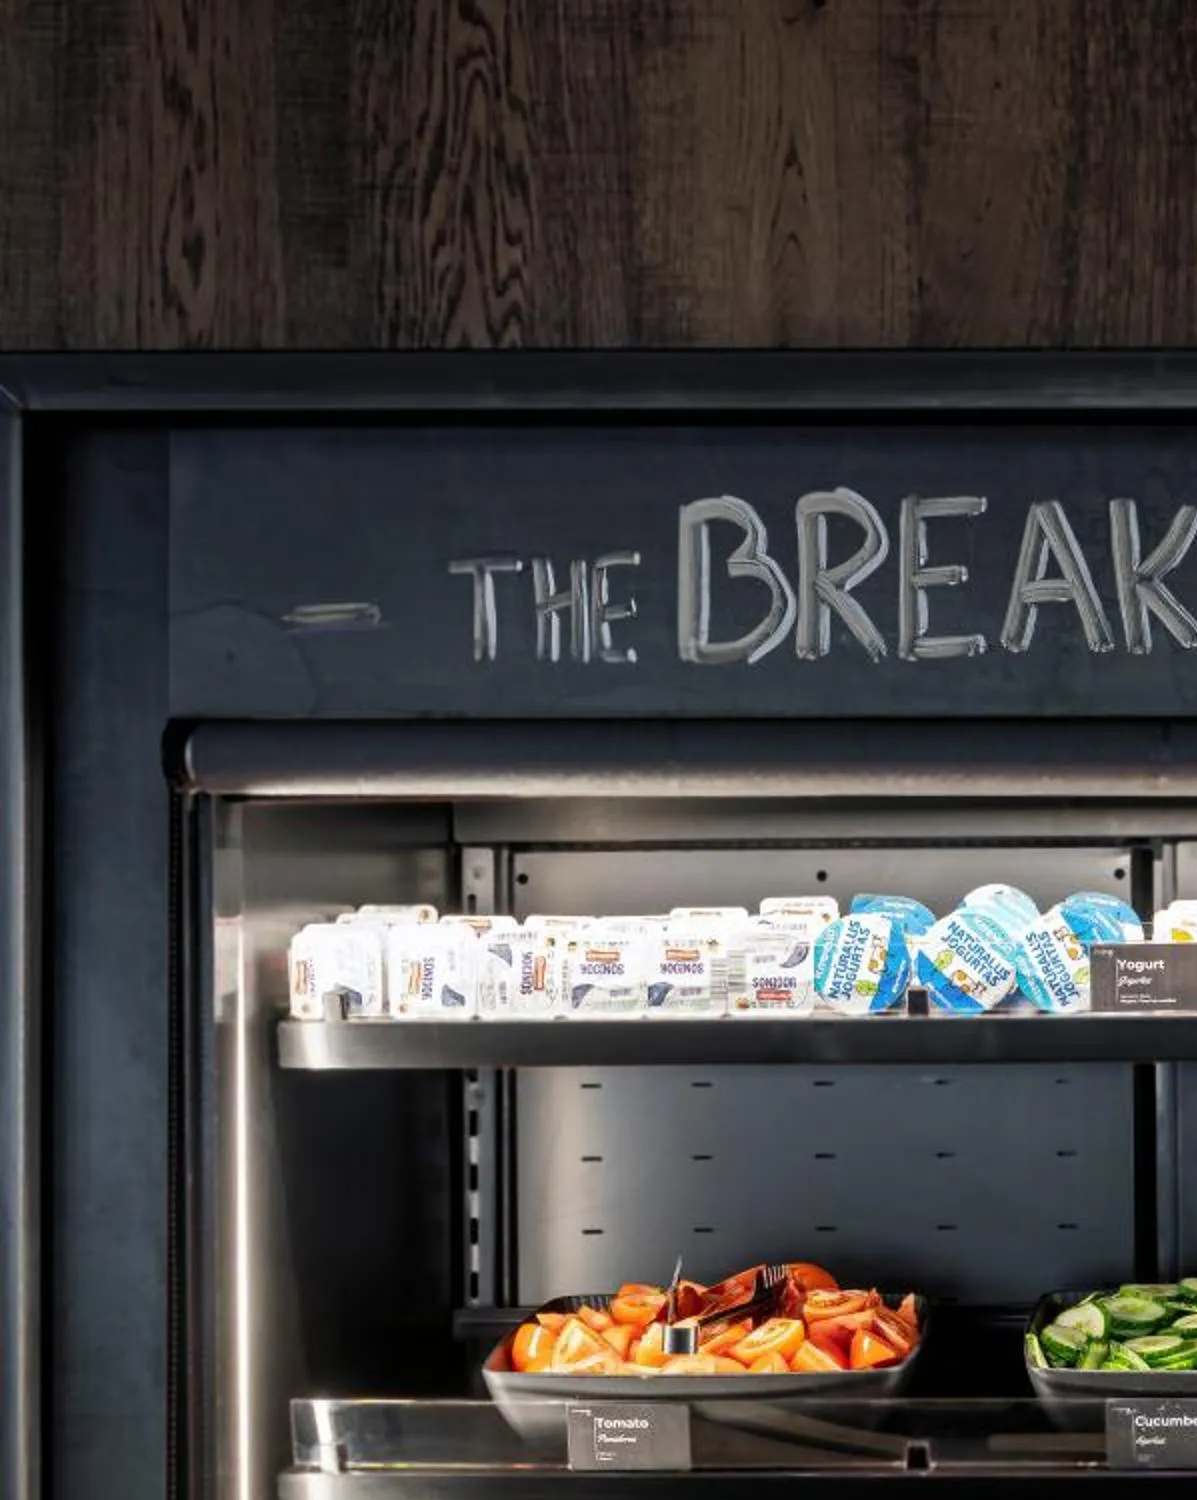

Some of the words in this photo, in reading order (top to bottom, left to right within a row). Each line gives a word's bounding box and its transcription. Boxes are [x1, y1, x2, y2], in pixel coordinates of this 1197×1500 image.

[449, 550, 640, 663] THE
[941, 934, 1000, 988] JOGURTAS
[1117, 959, 1165, 972] Yogurt
[596, 1418, 649, 1429] Tomato
